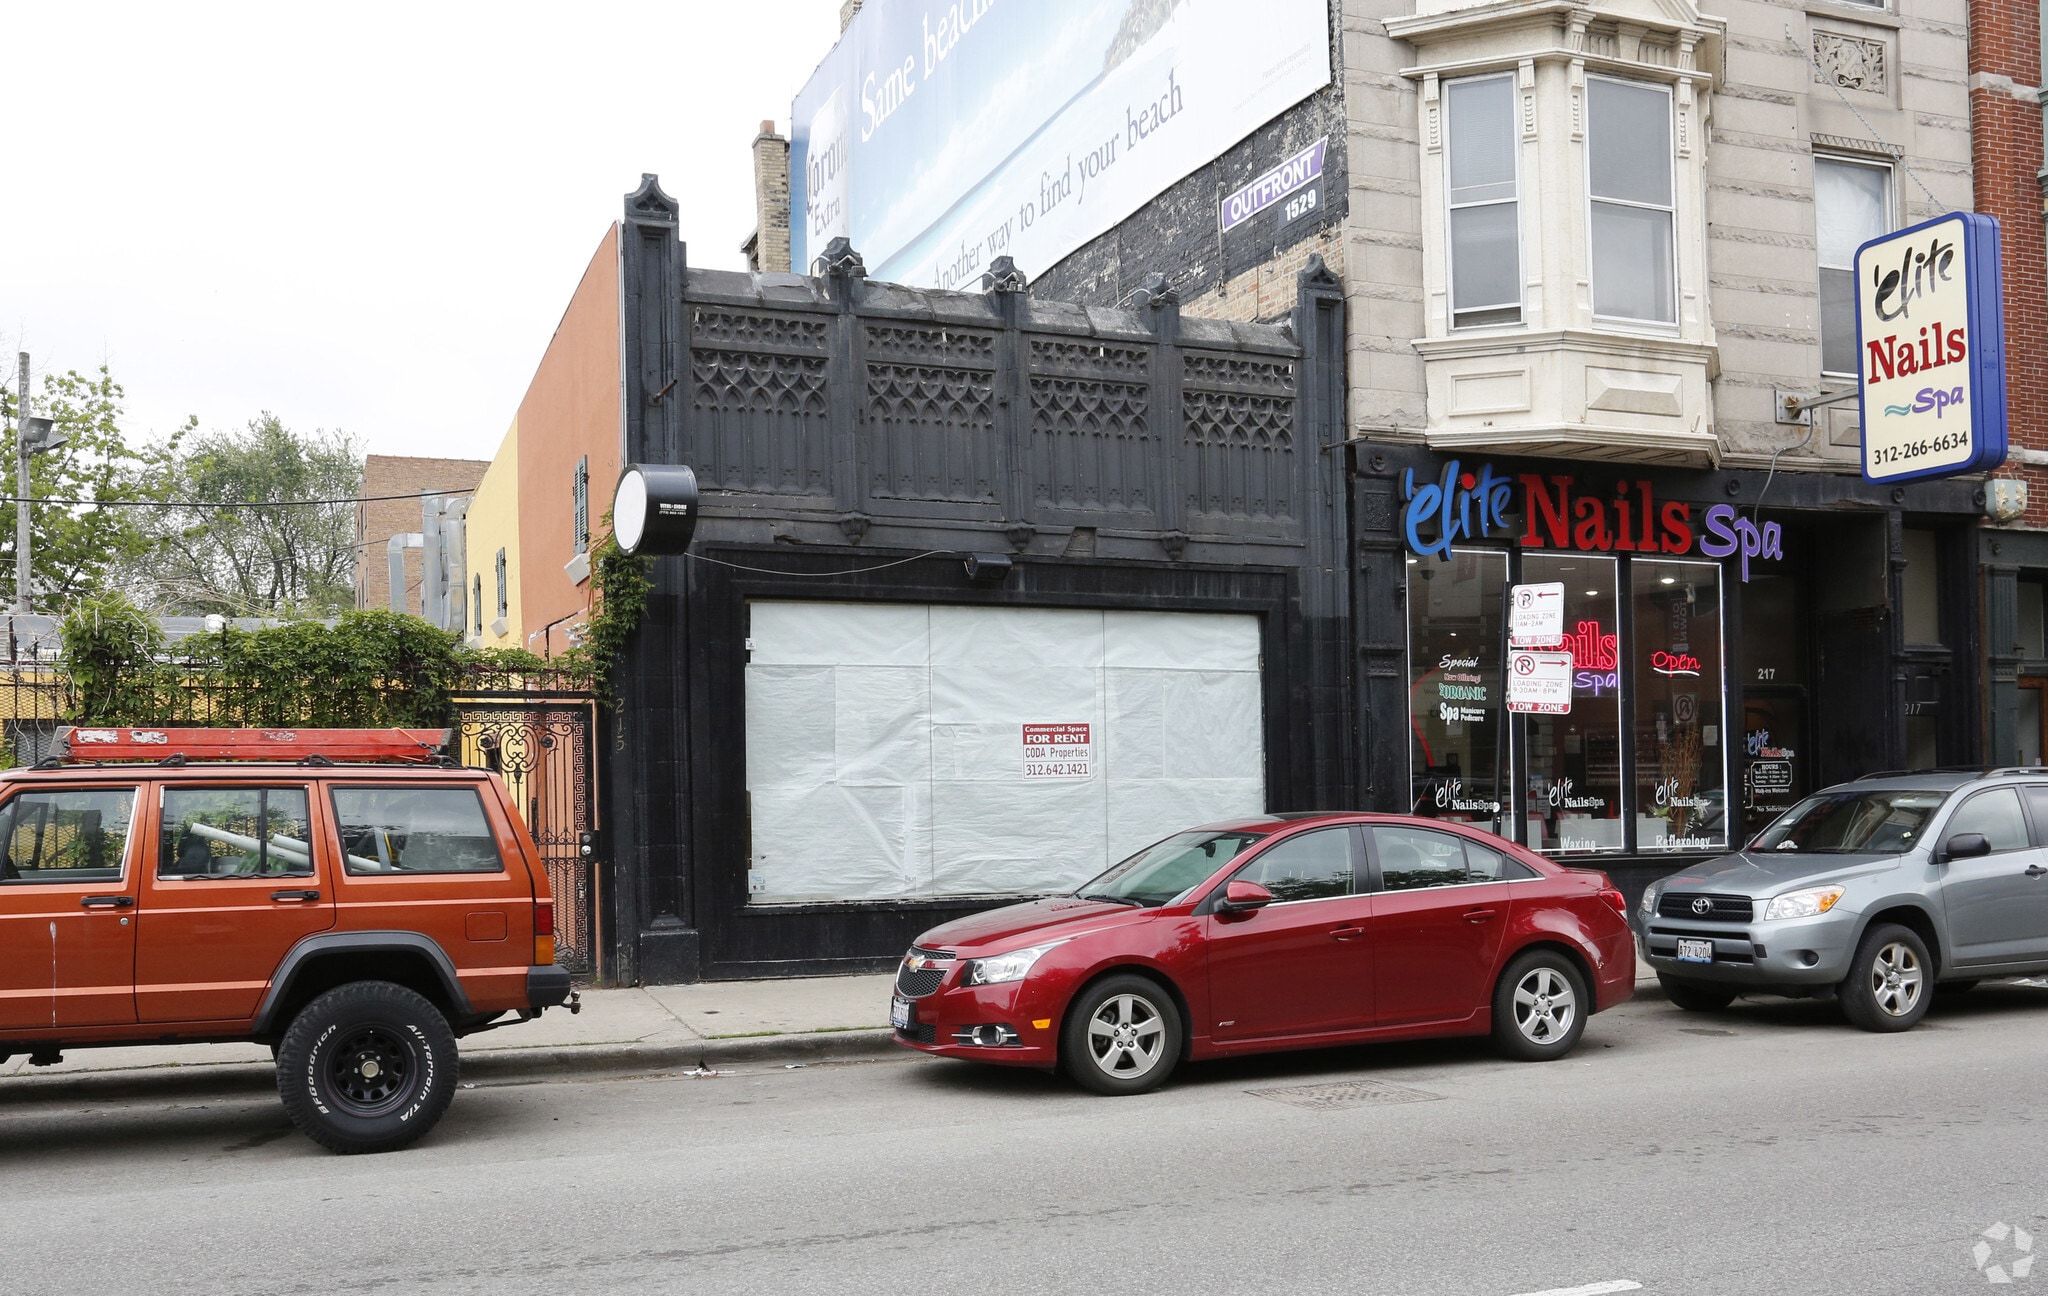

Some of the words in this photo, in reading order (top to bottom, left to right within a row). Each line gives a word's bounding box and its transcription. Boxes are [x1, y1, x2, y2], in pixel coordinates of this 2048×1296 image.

[861, 54, 916, 143] Same
[933, 239, 983, 291] Another
[987, 216, 1014, 258] way
[1018, 202, 1035, 233] to
[1039, 152, 1072, 218] find
[1077, 132, 1120, 207] your
[1126, 67, 1184, 151] beach
[1230, 148, 1316, 221] OUTFRONT
[1284, 188, 1317, 222] 1529
[814, 196, 841, 236] Extra
[1867, 321, 1967, 385] Nails
[1911, 386, 1965, 419] Spa
[1874, 430, 1969, 466] 312-266-6634
[1518, 473, 1693, 555] Nails
[1700, 503, 1784, 584] Spa
[1514, 613, 1539, 621] LOADING
[1541, 612, 1556, 620] ZONE
[1515, 636, 1532, 645] TOW
[1536, 635, 1558, 644] ZONE
[1438, 653, 1480, 671] Special
[1652, 650, 1702, 678] Open
[1757, 668, 1776, 680] 217
[1440, 684, 1487, 701] ORGANIC
[1513, 680, 1542, 688] LOADING
[1572, 671, 1617, 697] Spa
[1440, 702, 1460, 726] Spa
[1460, 706, 1486, 715] Manicure
[1513, 702, 1533, 711] TOW
[1537, 703, 1565, 712] ZONE
[1904, 703, 1921, 715] 217
[1460, 714, 1484, 722] Pedicure
[1024, 725, 1065, 733] Commercial
[1067, 725, 1088, 734] Space
[1026, 734, 1051, 744] FOR
[1054, 733, 1087, 743] RENT
[1025, 747, 1046, 758] CODA
[1050, 746, 1088, 759] Properties
[1026, 763, 1089, 776] 312.642.1421
[1560, 835, 1597, 852] Waxing
[1655, 833, 1711, 850] Reflexology
[1694, 946, 1712, 959] 4204
[307, 1024, 337, 1114] BFGoodrich
[406, 1024, 434, 1101] All-Terrain
